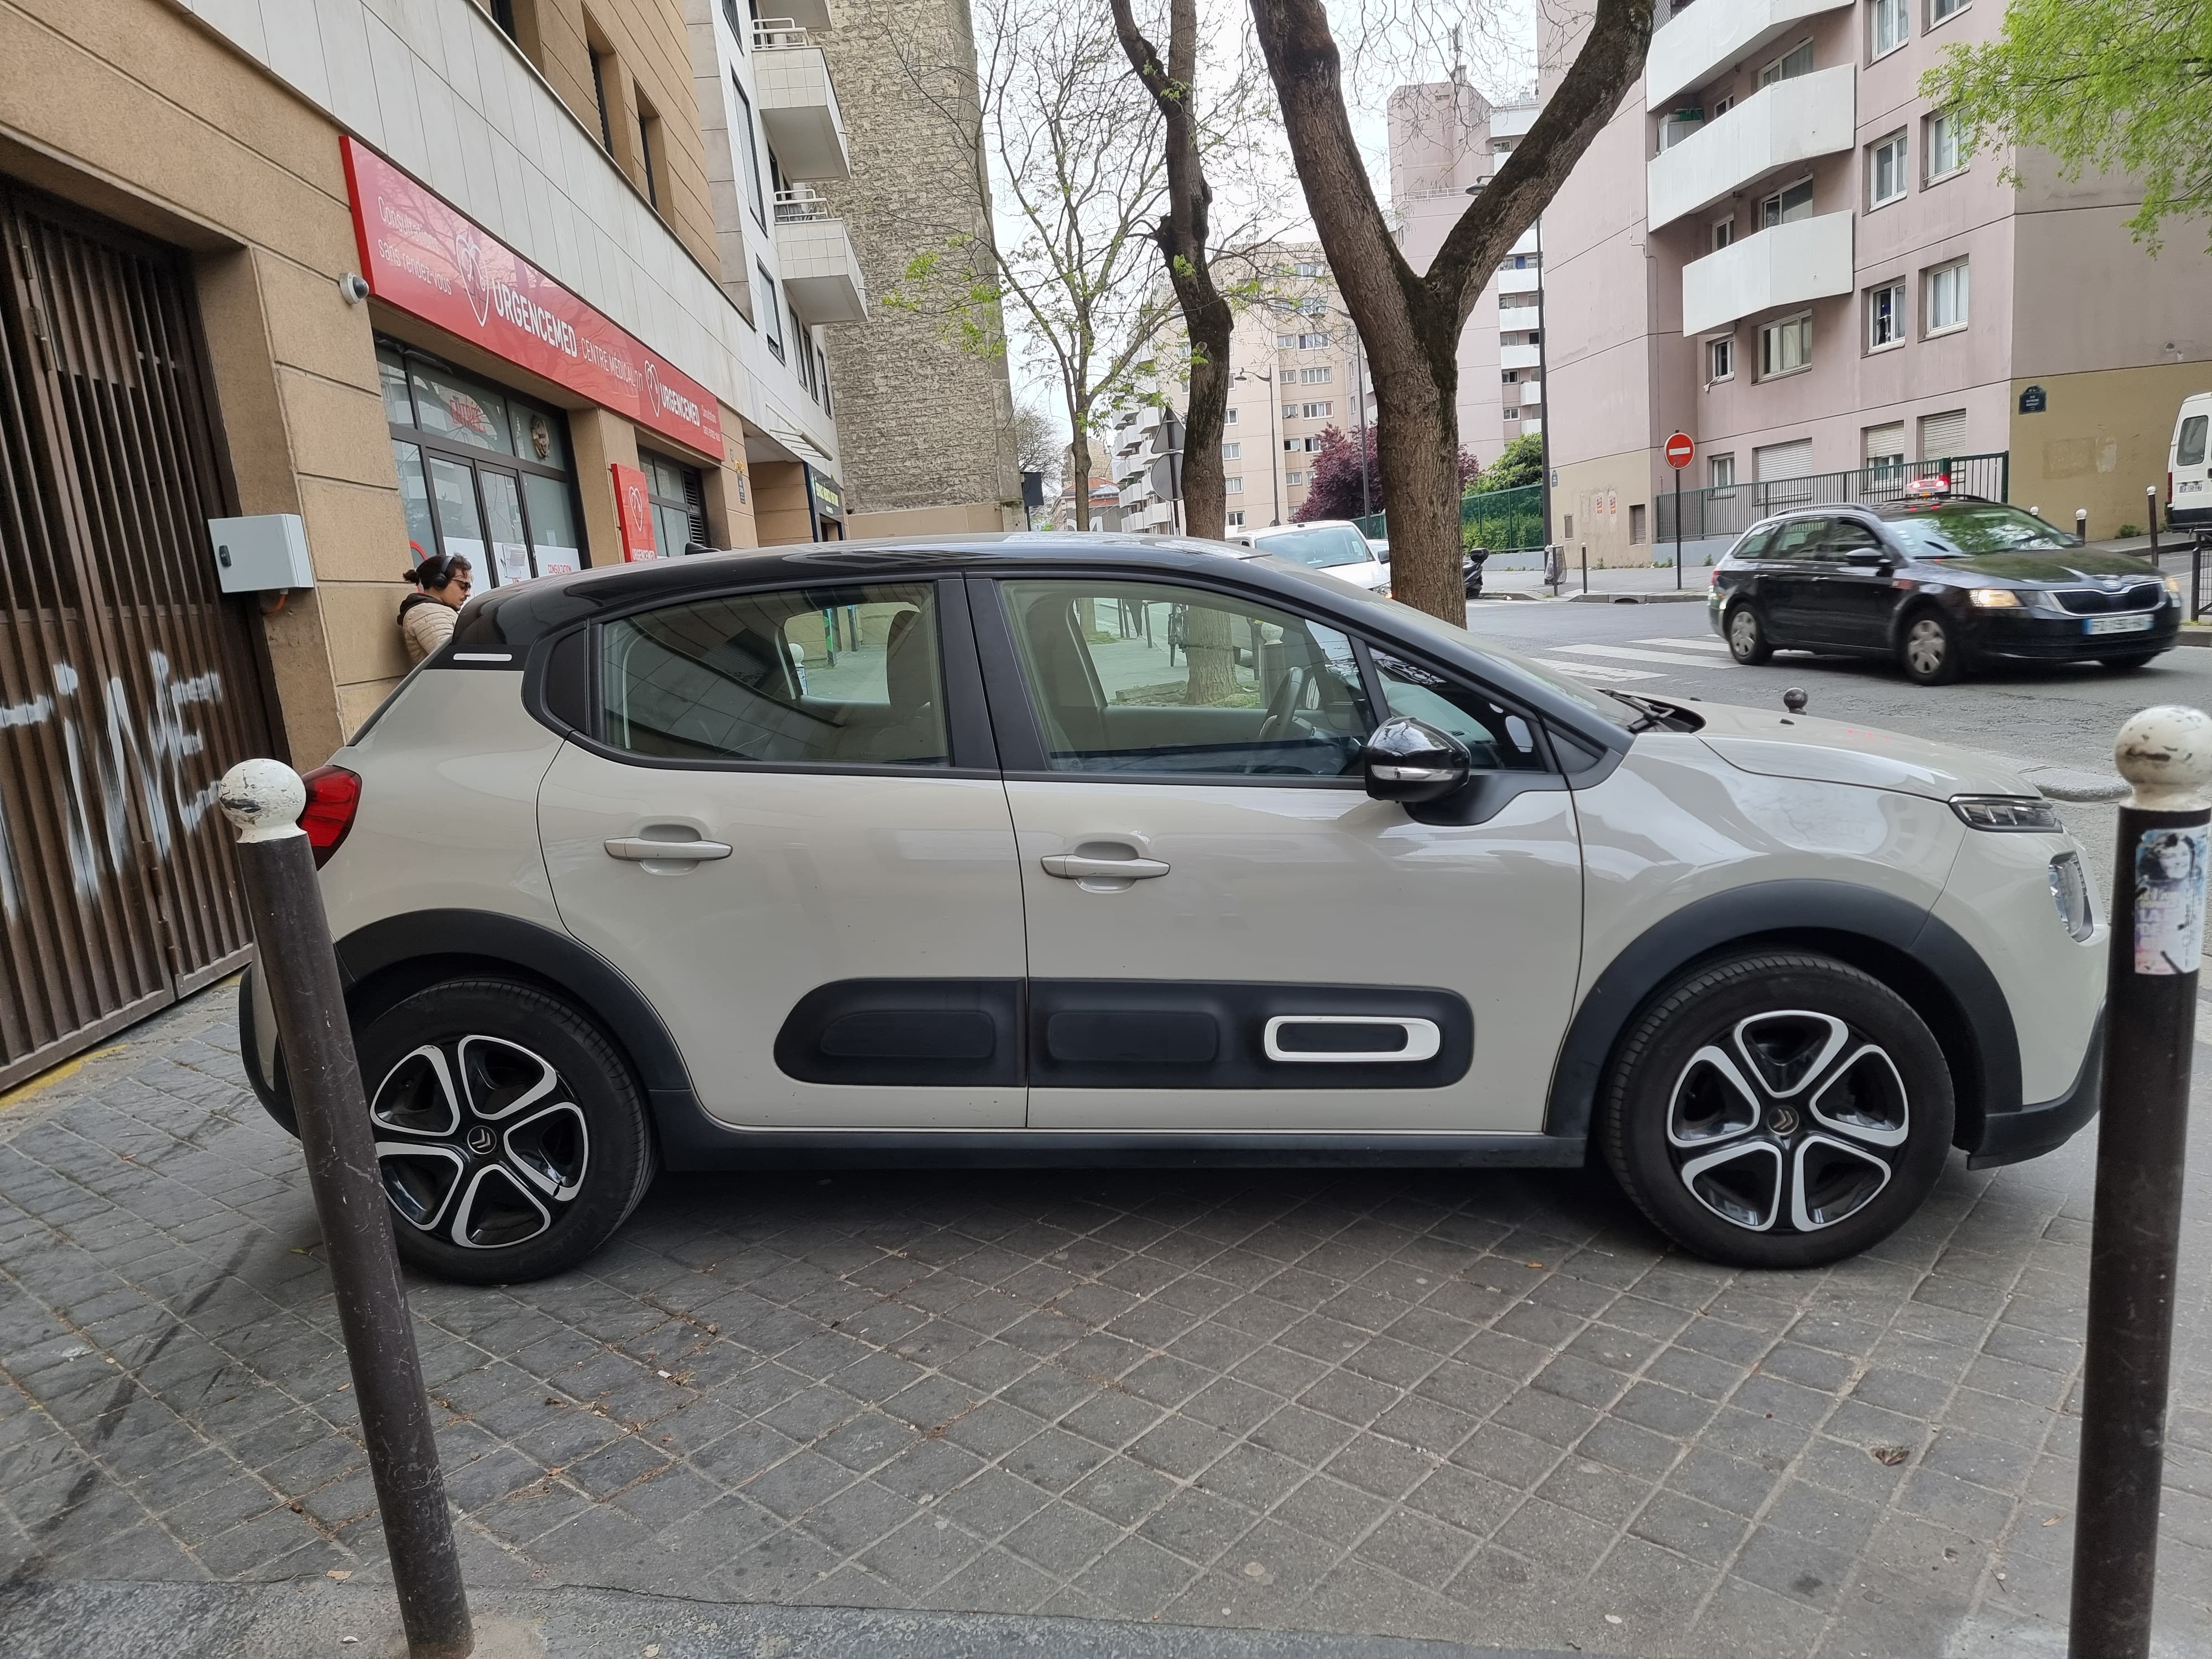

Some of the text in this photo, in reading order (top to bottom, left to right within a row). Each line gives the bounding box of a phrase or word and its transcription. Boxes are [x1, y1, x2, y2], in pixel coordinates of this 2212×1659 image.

[378, 238, 452, 295] sans rendez-vous
[492, 277, 578, 358] URGENCEMED
[581, 337, 609, 372] CENTRE
[659, 382, 700, 427] URGENCEMED
